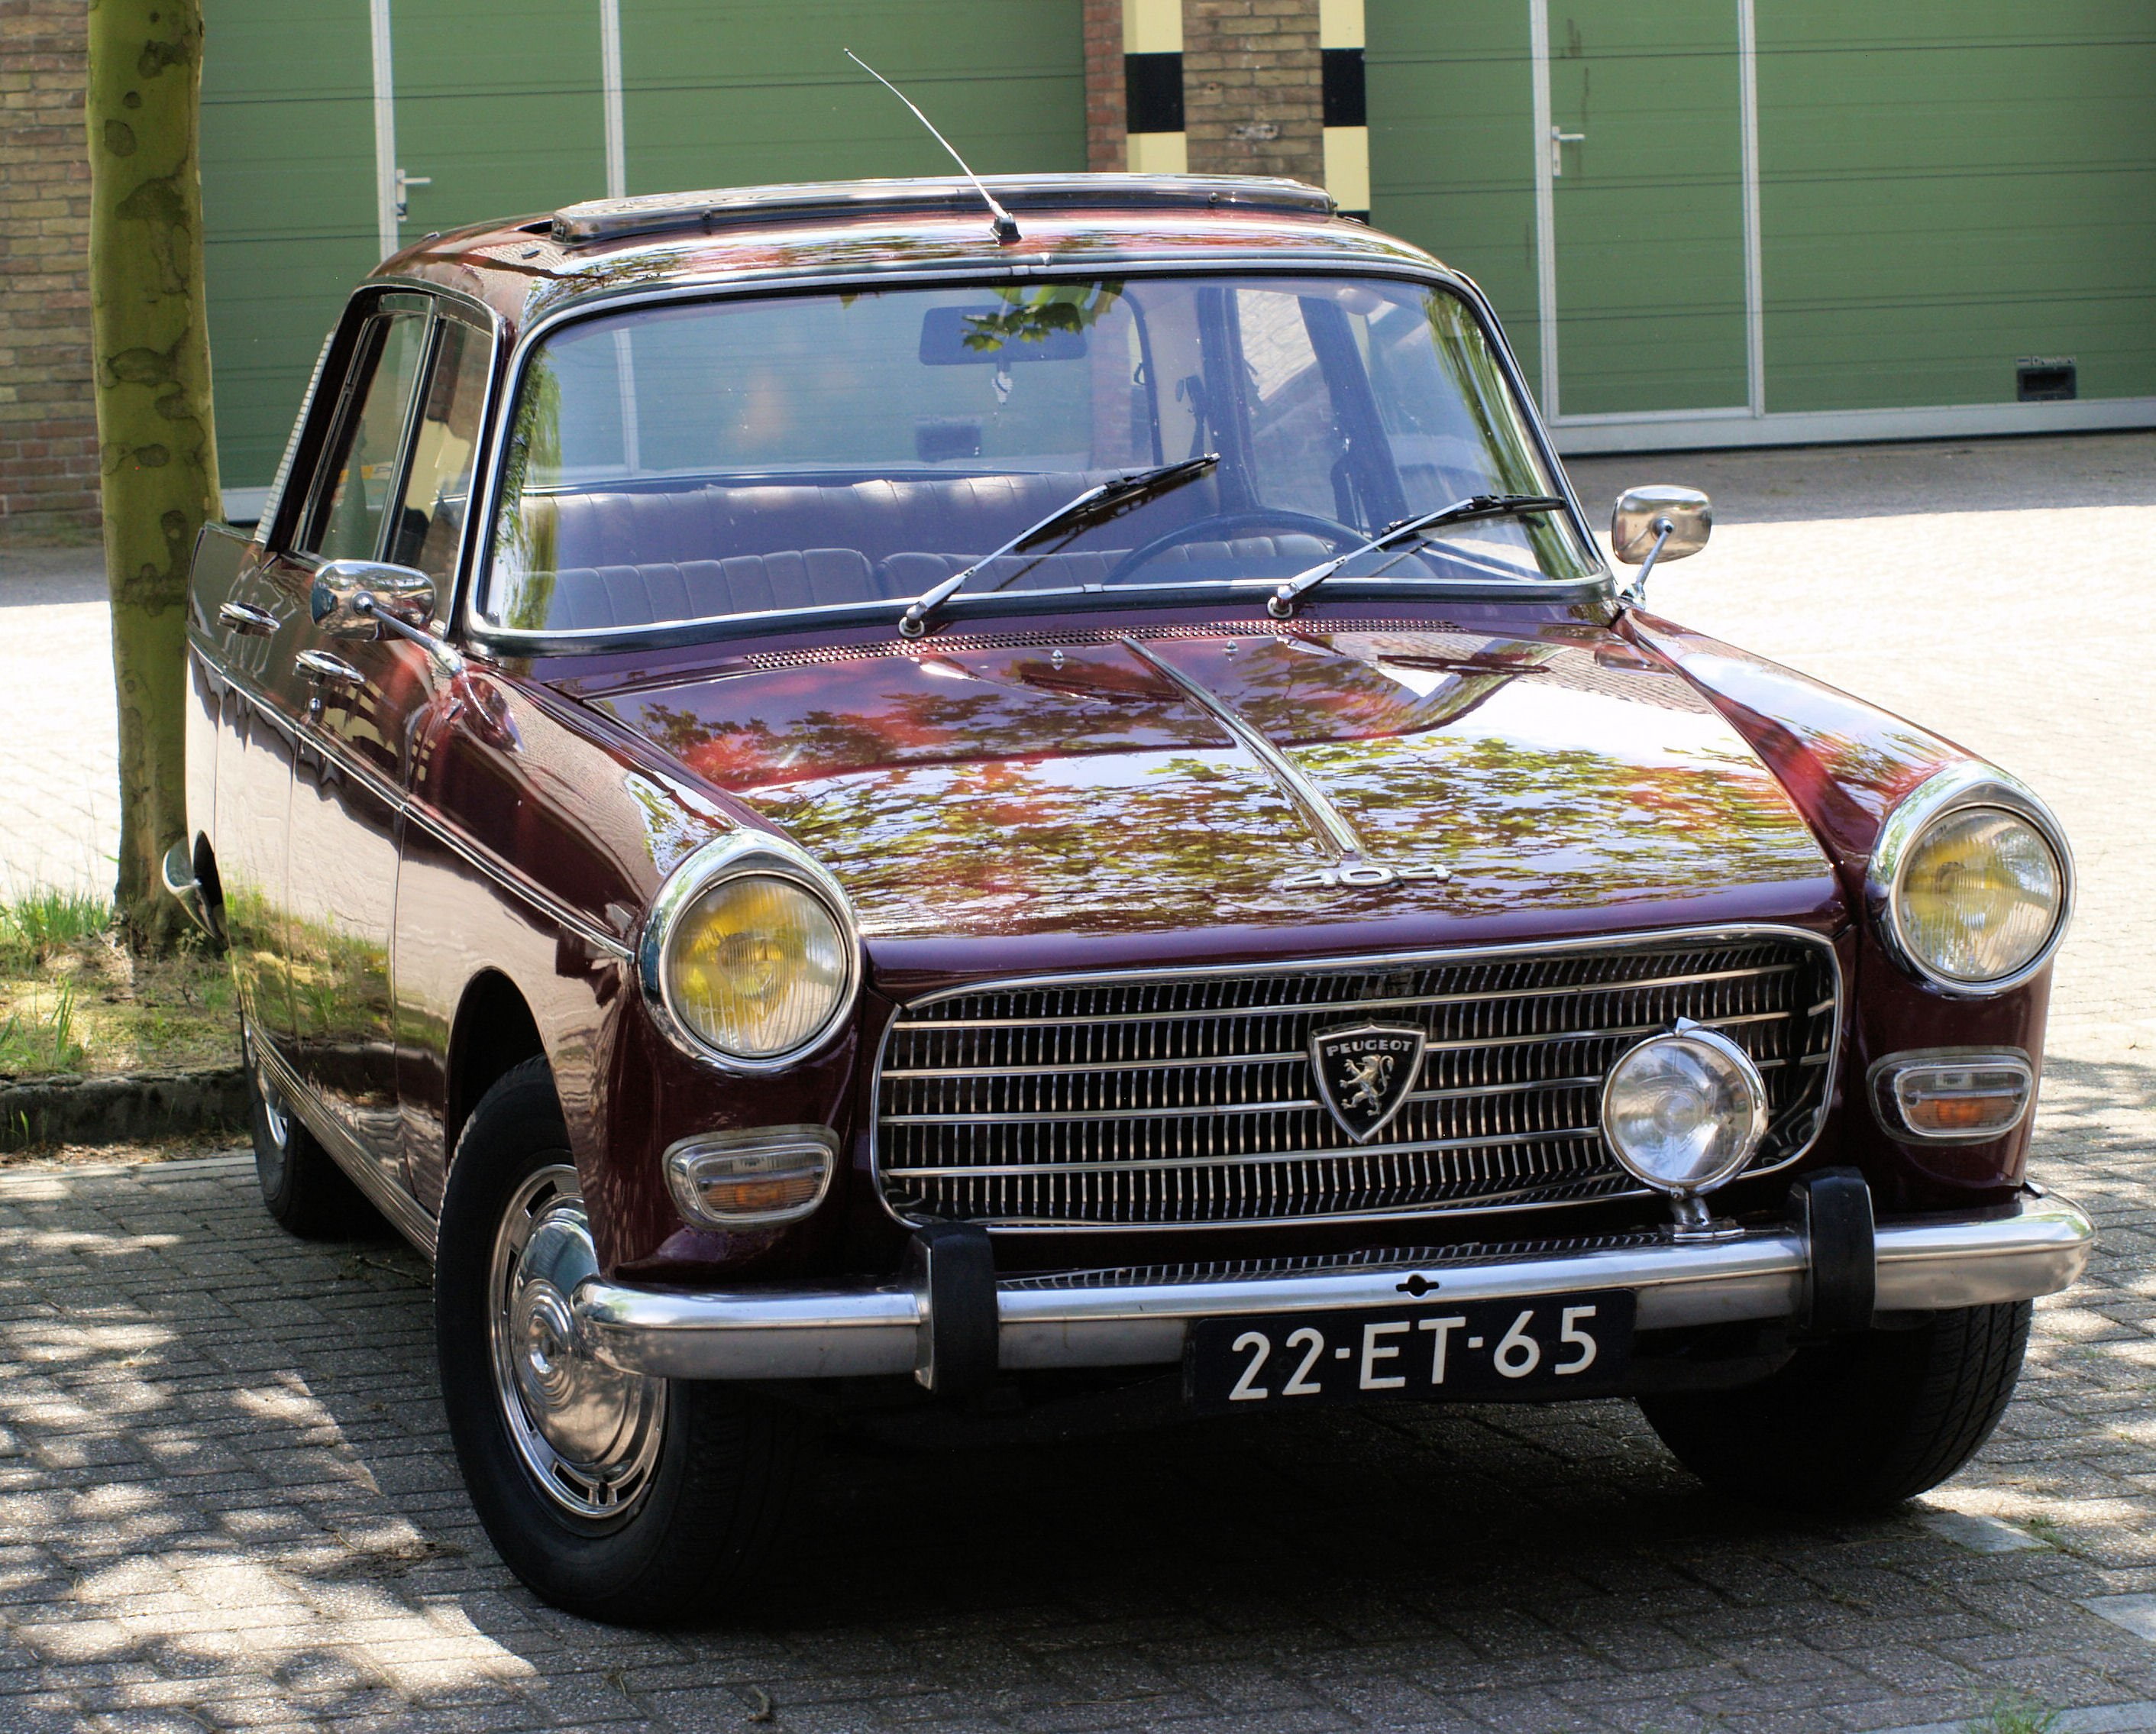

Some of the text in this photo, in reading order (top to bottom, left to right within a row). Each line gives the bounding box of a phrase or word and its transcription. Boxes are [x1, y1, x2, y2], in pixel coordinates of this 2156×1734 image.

[1282, 864, 1451, 890] 404
[1326, 1039, 1413, 1056] PEUGEOT
[1228, 1305, 1597, 1401] 22-ET-65
